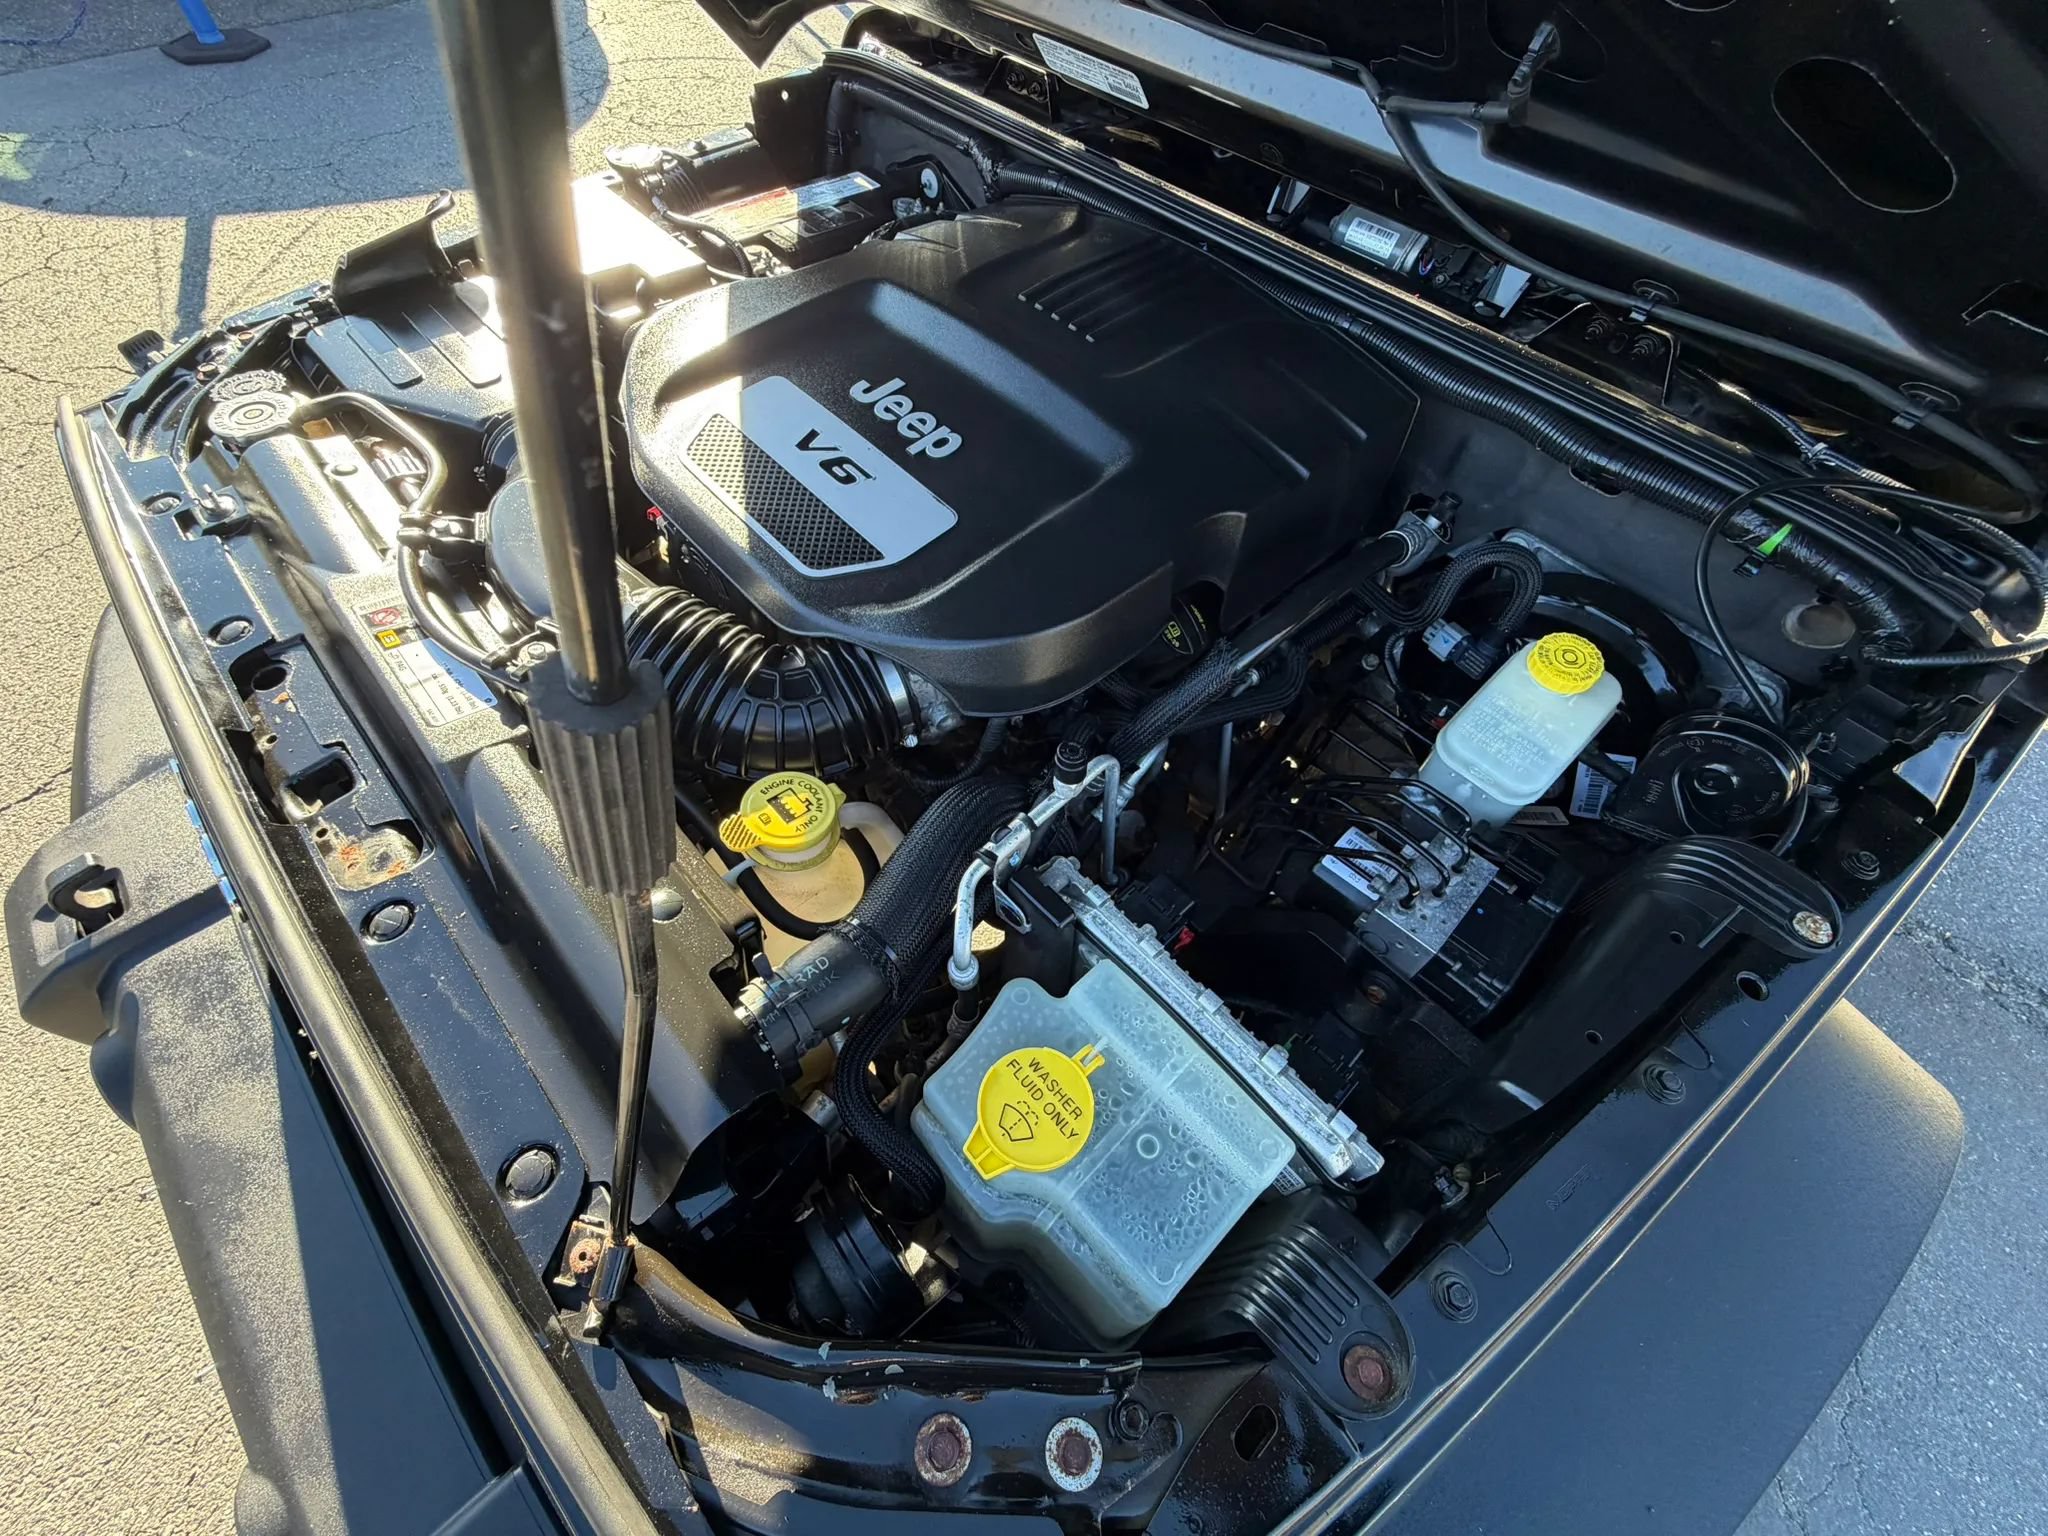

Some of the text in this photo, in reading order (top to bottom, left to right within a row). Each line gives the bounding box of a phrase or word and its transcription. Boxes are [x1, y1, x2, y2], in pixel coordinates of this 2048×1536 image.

[850, 377, 963, 458] Jeep
[795, 428, 876, 485] V6
[760, 779, 823, 833] ENGINE COOLANT ONLY
[1006, 1058, 1079, 1140] FLUID ONLY
[1028, 1057, 1083, 1121] WASHER
